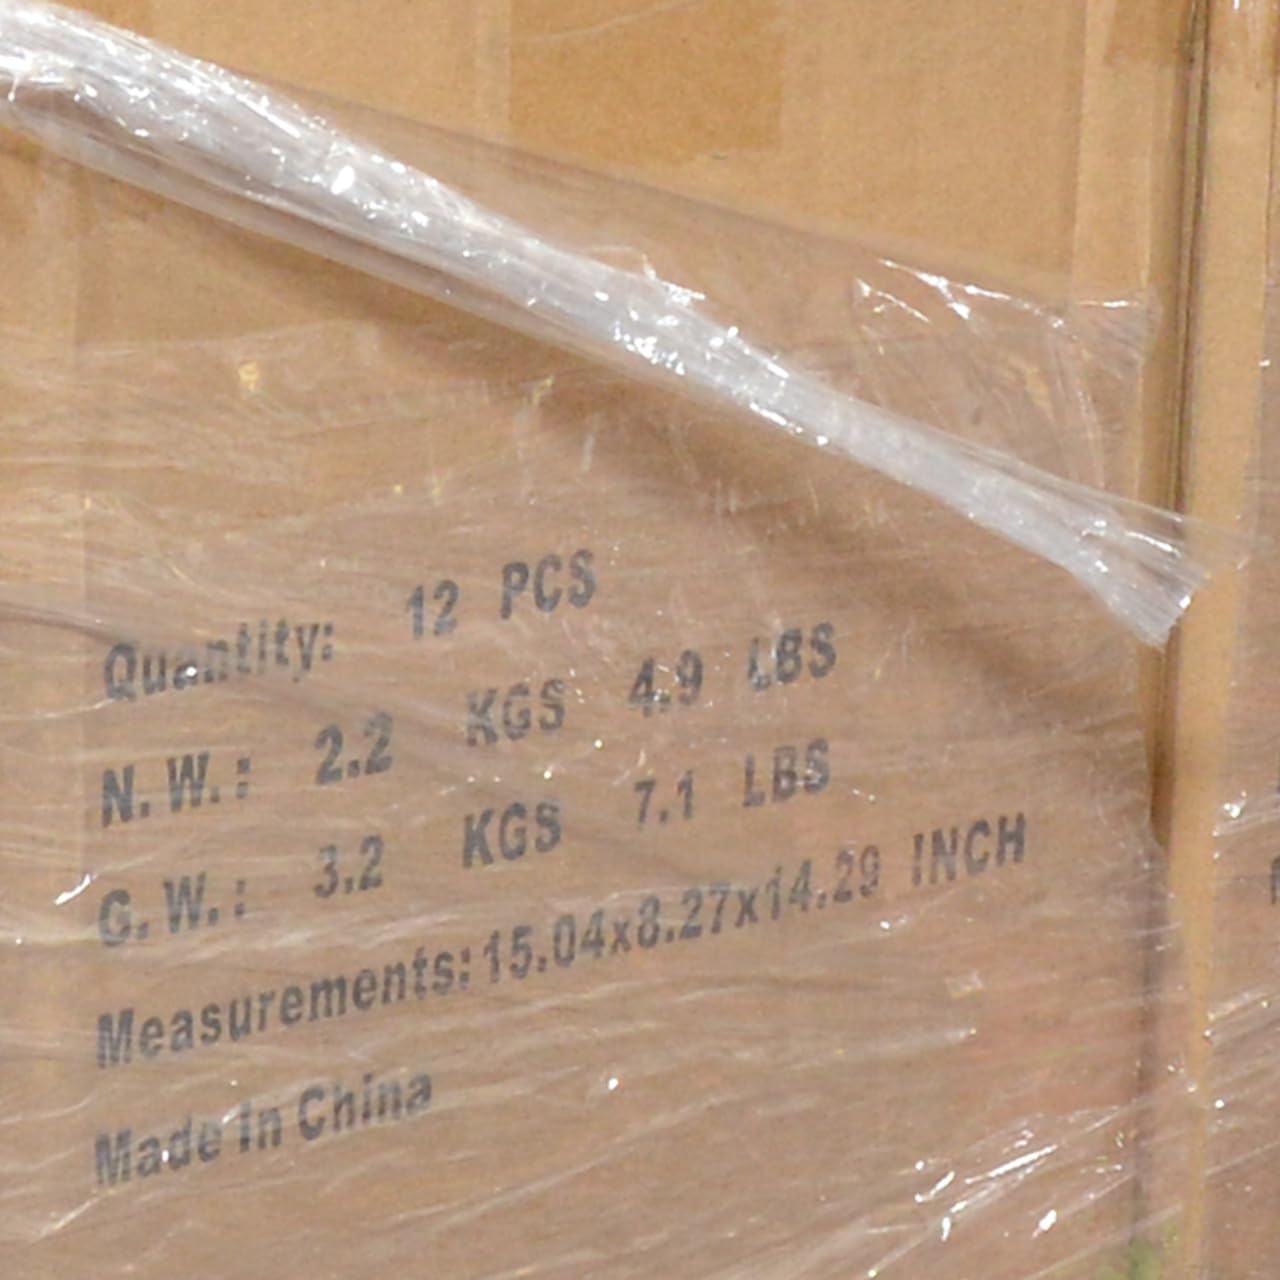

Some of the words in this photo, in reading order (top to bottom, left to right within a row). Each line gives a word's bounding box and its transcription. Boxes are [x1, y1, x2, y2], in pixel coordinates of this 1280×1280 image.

[104, 618, 333, 701] Quantity:
[406, 580, 460, 640] 12
[501, 549, 596, 620] PCS
[314, 711, 394, 785] 2.2
[465, 678, 567, 746] KGS
[628, 650, 703, 717] 4.9
[747, 622, 837, 691] LBS
[314, 834, 385, 898] 3.2
[462, 800, 562, 868] KGS
[634, 770, 696, 830] 7.1
[742, 739, 830, 808] LBS
[911, 812, 1026, 887] INCH
[94, 1112, 222, 1187] Made
[238, 1102, 282, 1151] in
[299, 1071, 433, 1142] China
